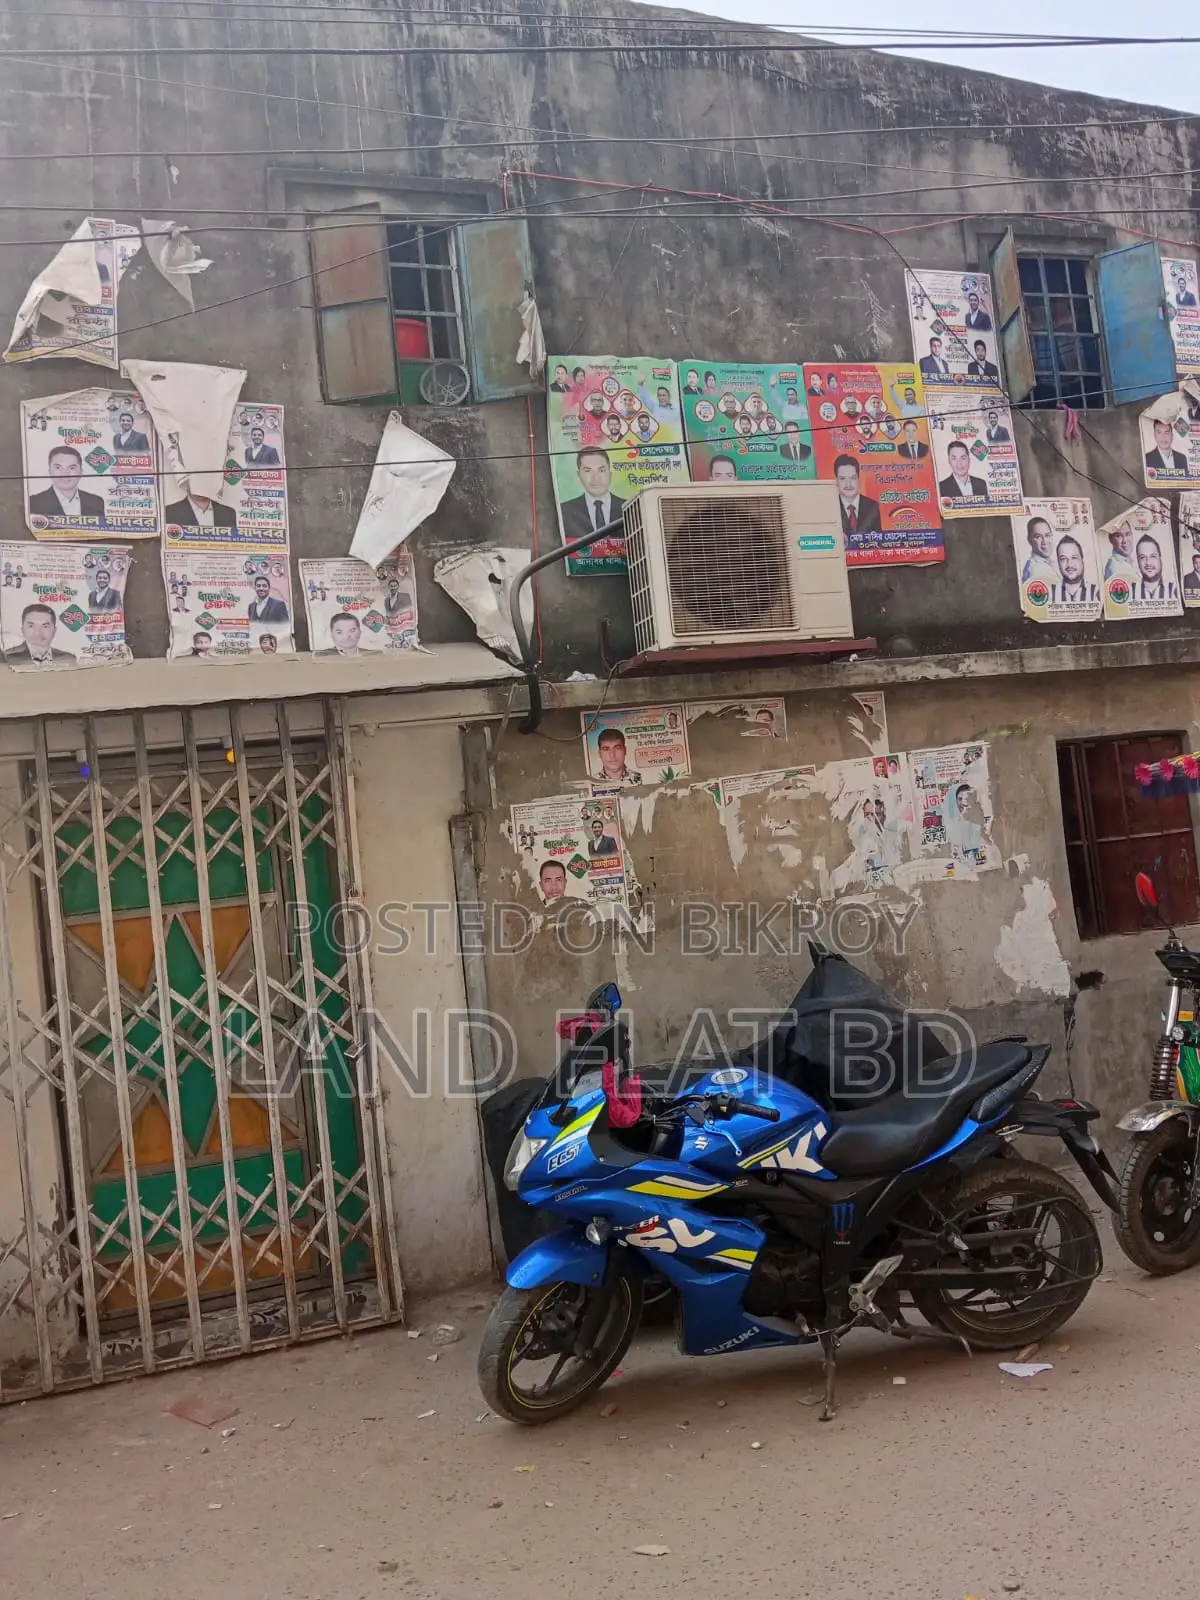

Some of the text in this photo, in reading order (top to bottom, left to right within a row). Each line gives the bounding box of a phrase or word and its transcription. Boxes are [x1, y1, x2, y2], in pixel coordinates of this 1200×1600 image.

[48, 515, 156, 528] জালাল মাদবর
[182, 525, 287, 539] জালাল মাদবর
[703, 1326, 760, 1355] SUZUKI
